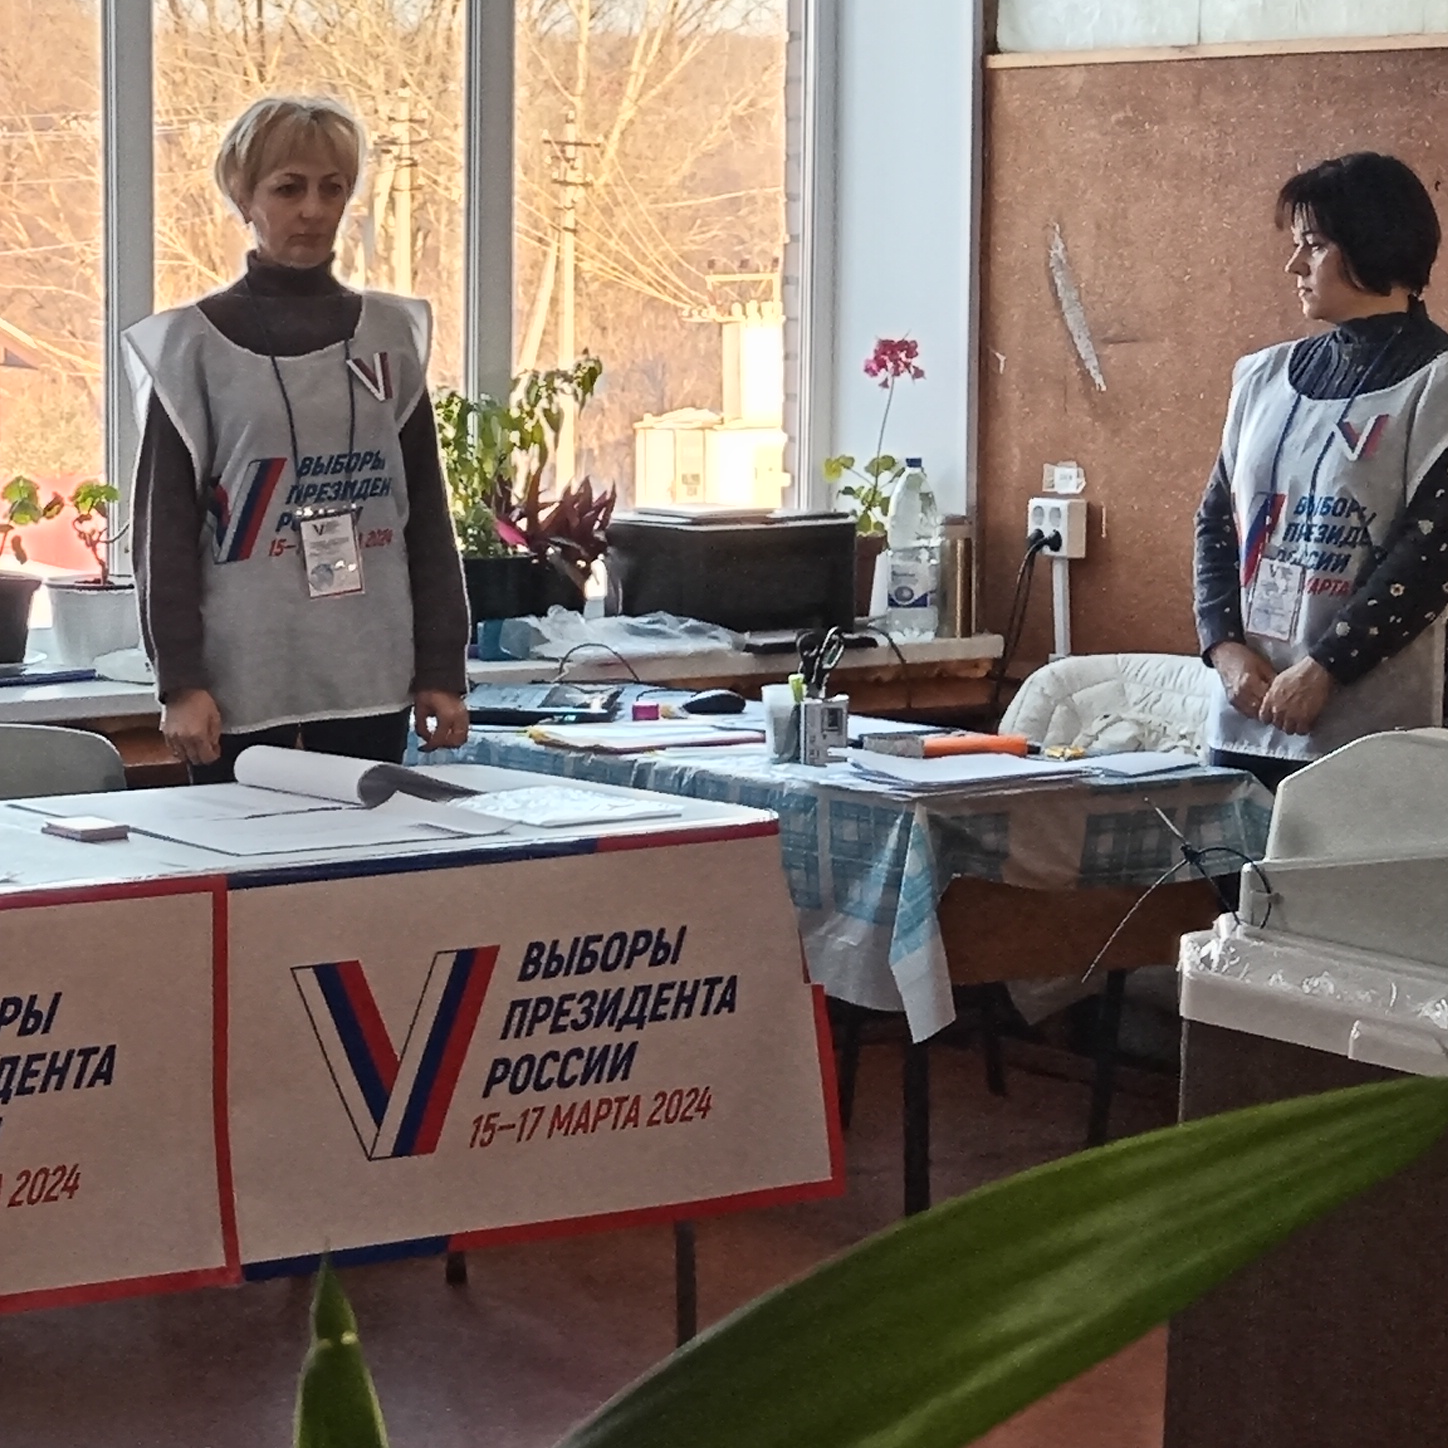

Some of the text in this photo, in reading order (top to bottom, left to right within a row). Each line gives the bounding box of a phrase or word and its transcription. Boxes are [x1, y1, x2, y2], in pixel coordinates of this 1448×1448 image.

[285, 477, 393, 506] ПРЕЗИДЕН
[517, 925, 688, 983] ВЫБОРЫ
[499, 975, 738, 1041] ПРЕЗИДЕНТА
[482, 1041, 639, 1099] РОССИИ
[547, 1094, 642, 1141] МАРТА
[646, 1086, 713, 1129] 2024
[7, 1163, 82, 1208] 2024
